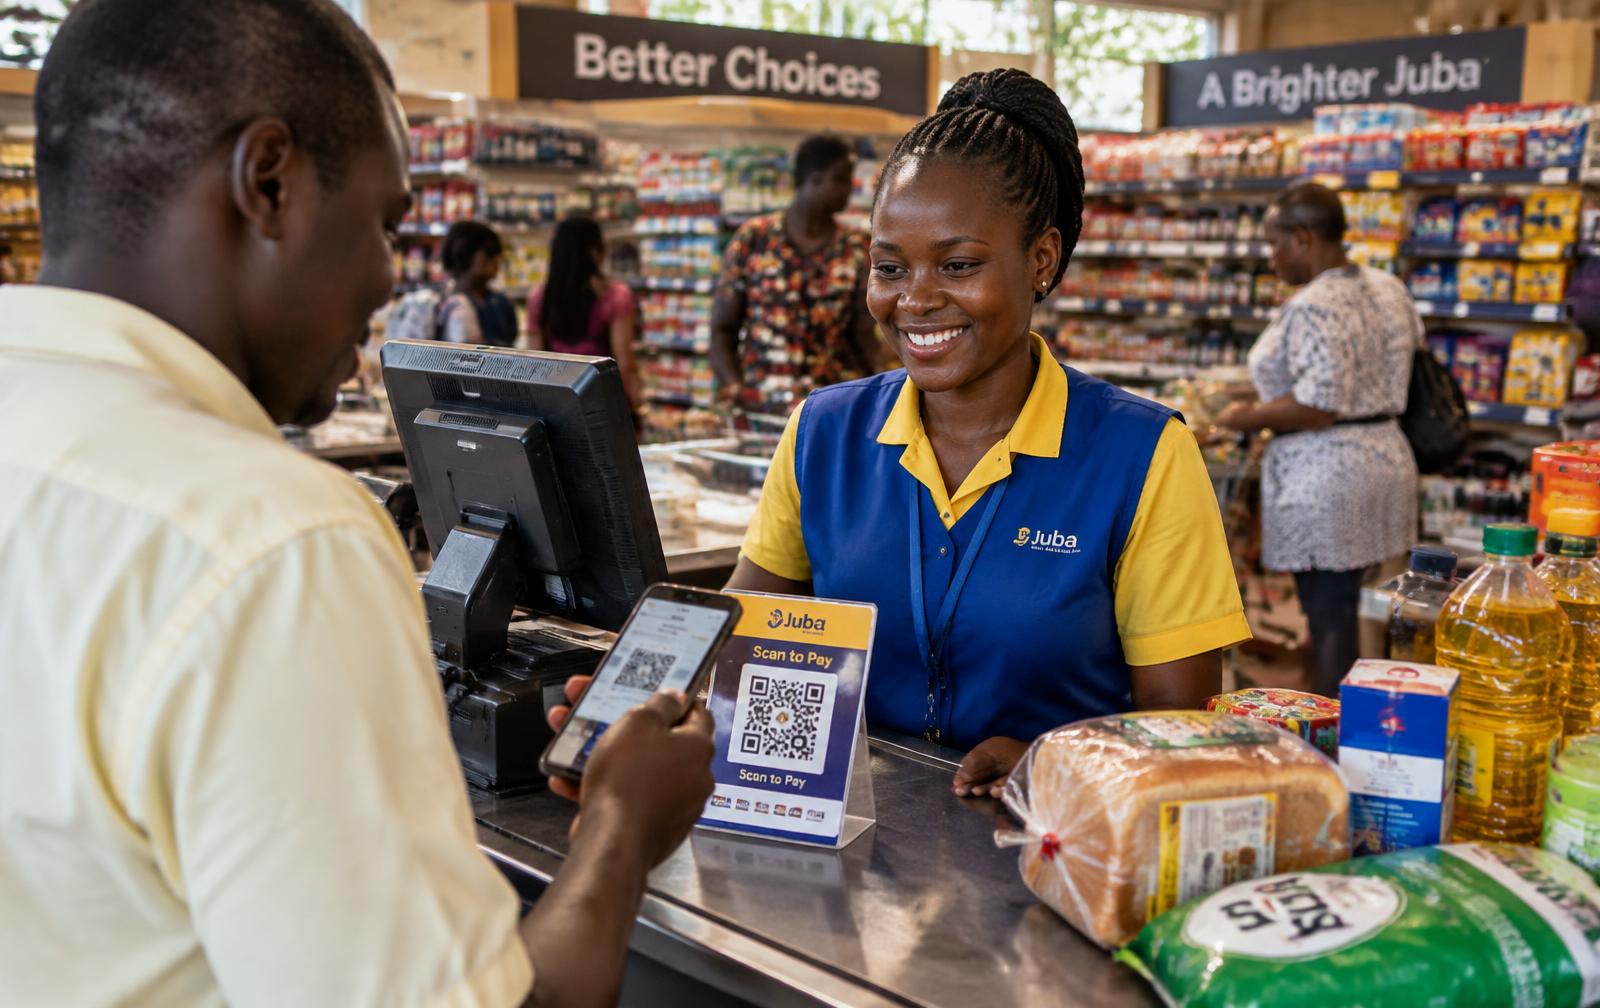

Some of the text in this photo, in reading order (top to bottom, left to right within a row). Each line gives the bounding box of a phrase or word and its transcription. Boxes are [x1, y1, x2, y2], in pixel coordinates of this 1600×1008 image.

[574, 33, 881, 99] Better Choices
[1197, 51, 1482, 114] A Brighter Juba
[1031, 530, 1077, 548] Juba
[784, 612, 826, 631] Juba
[752, 645, 833, 669] Scan to Pay
[739, 769, 806, 788] Scan to Pay
